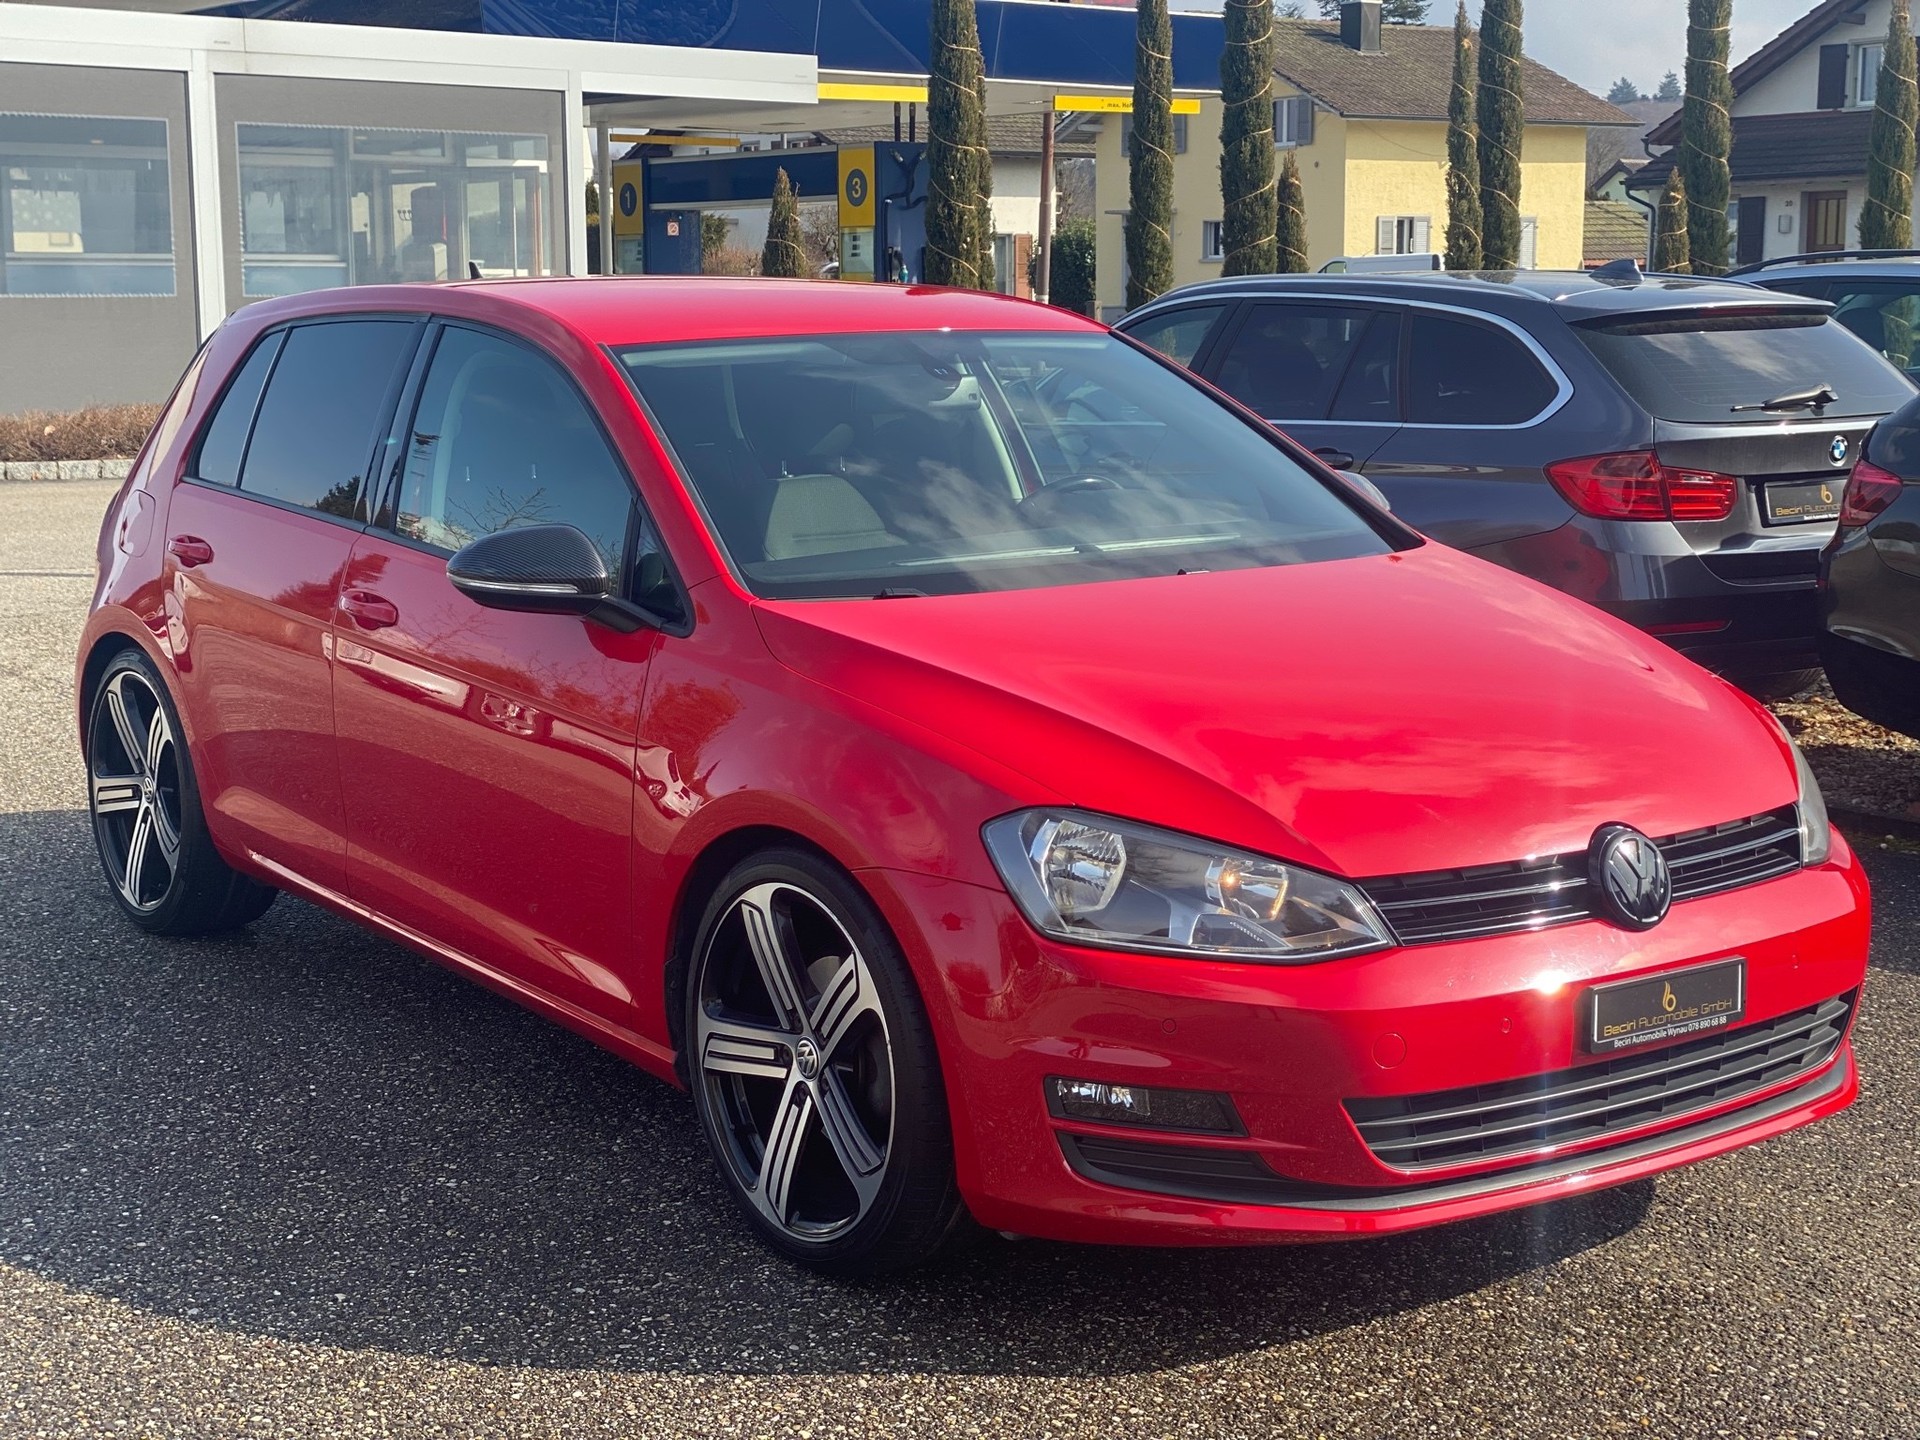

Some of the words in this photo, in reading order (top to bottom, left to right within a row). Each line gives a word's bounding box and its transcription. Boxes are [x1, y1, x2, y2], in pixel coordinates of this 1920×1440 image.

[625, 190, 632, 209] 1
[852, 178, 862, 198] 3
[1603, 1020, 1636, 1037] Beciri
[1639, 1007, 1699, 1028] Automobile
[1700, 998, 1733, 1015] GmbH
[1614, 1037, 1632, 1048] Beciri
[1631, 1029, 1667, 1044] Automobile
[1667, 1026, 1688, 1037] Wynau
[1687, 1022, 1700, 1032] 078
[1699, 1019, 1711, 1029] 890
[1711, 1018, 1719, 1026] 68
[1719, 1015, 1727, 1024] 88
